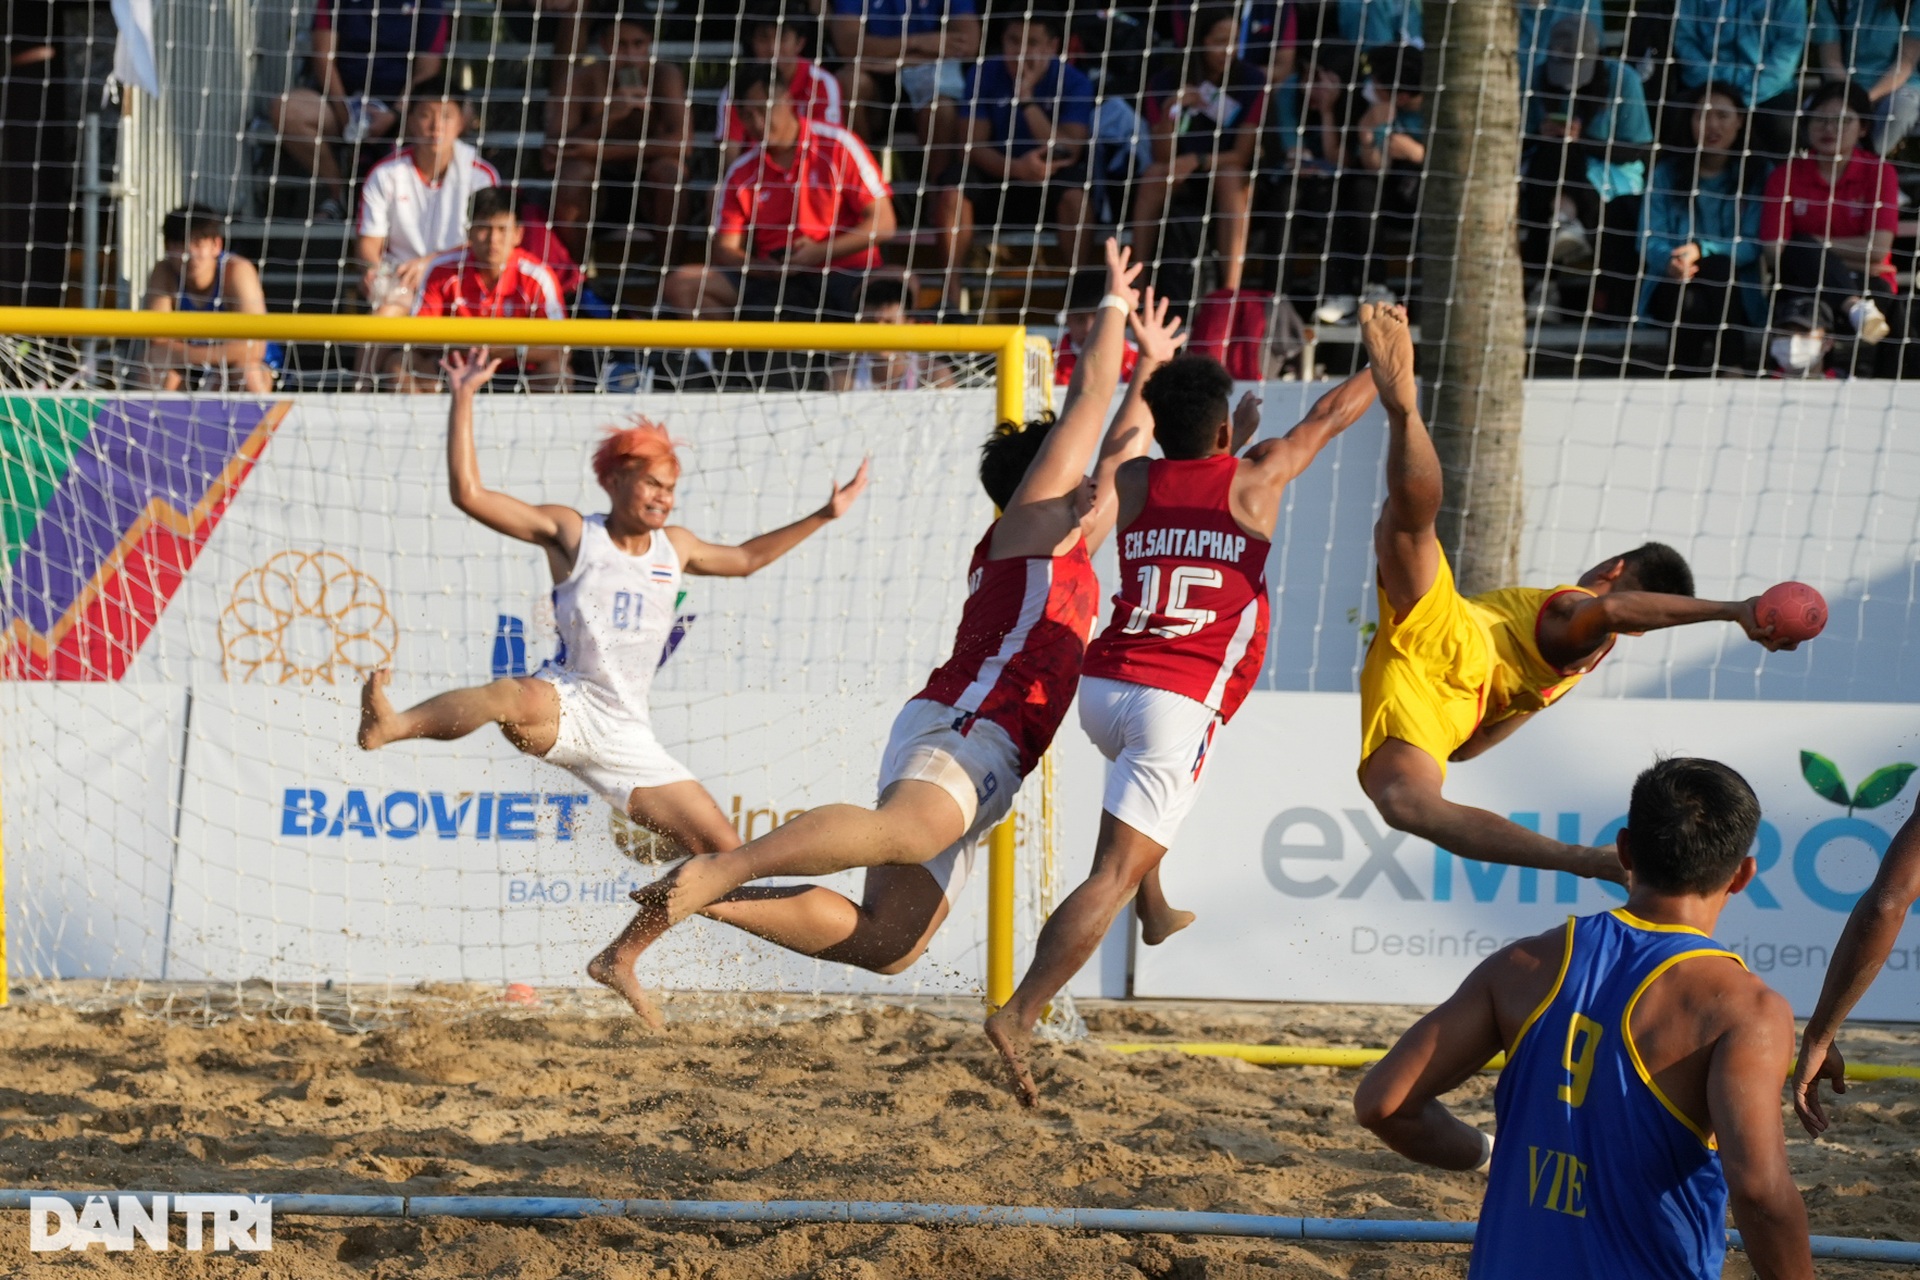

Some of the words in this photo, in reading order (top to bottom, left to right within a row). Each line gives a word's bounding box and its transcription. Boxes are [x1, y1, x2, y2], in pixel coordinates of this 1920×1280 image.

[1124, 528, 1247, 563] CH.SAITAPHAP
[613, 592, 643, 630] 81
[1122, 565, 1223, 639] 15
[280, 788, 588, 841] BAOVIET
[1351, 926, 1520, 958] Desinfe
[1557, 1012, 1603, 1108] 9
[1528, 1146, 1588, 1218] VIE
